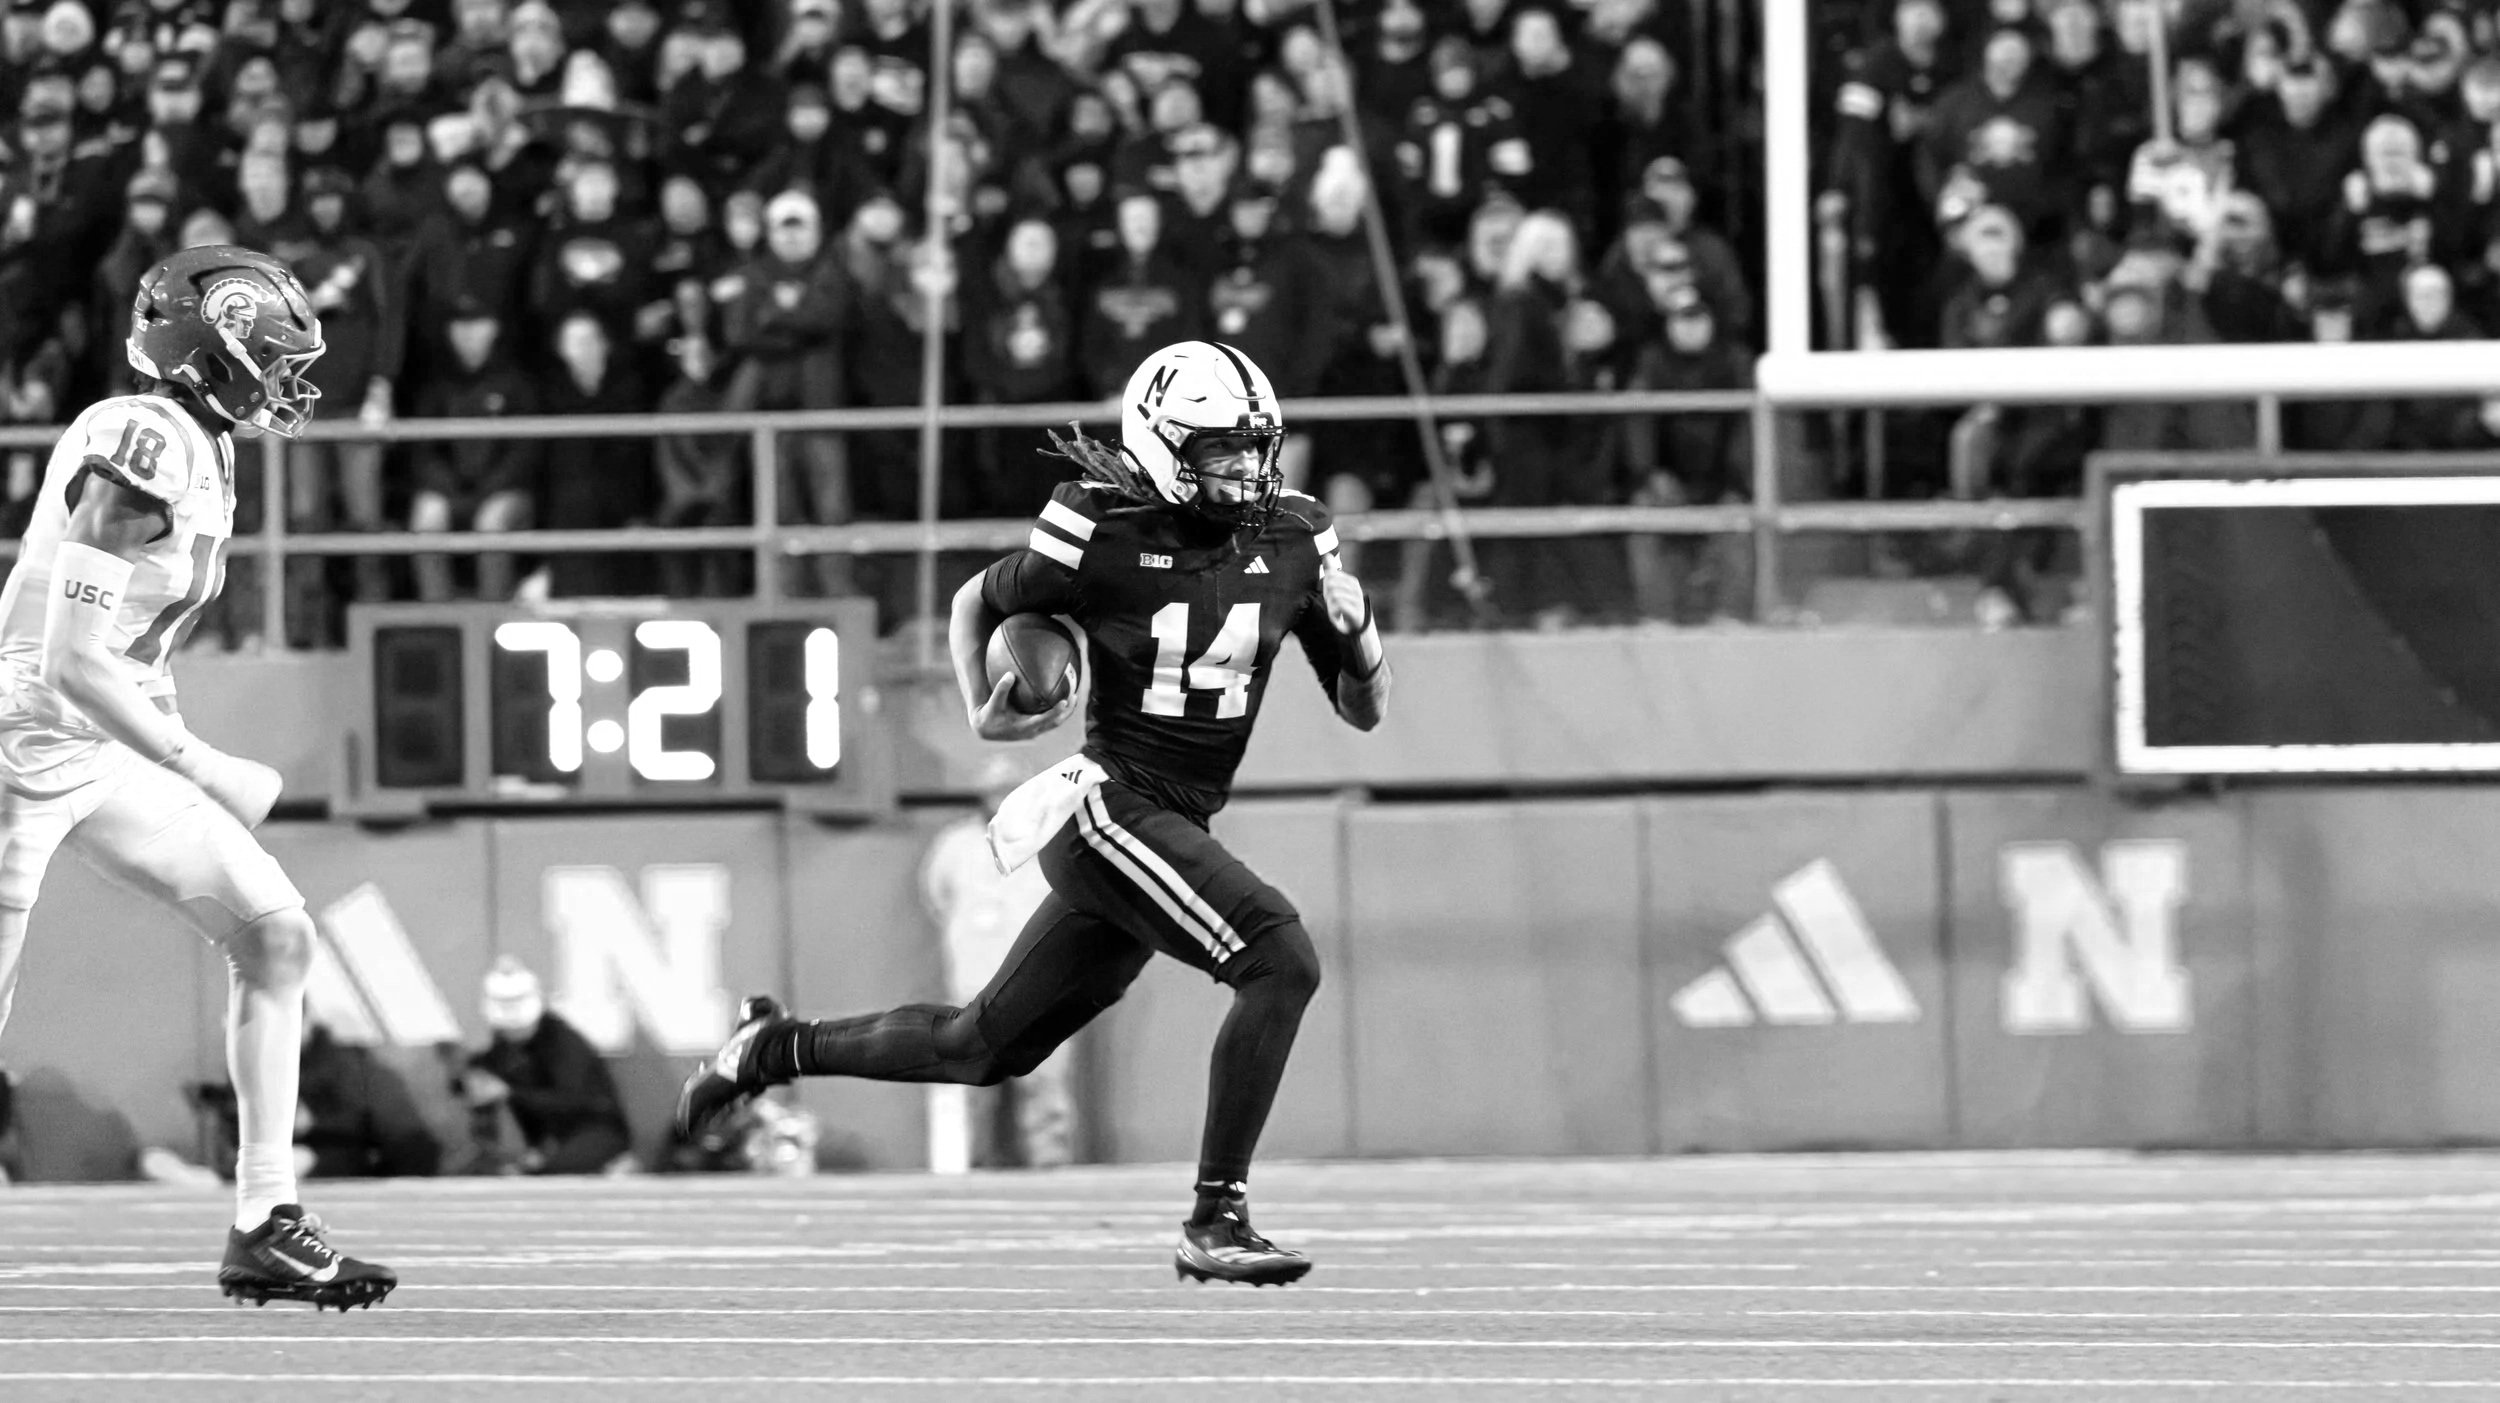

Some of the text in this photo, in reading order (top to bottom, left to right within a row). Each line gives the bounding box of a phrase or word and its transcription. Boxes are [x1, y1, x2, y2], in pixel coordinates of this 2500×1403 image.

[1144, 365, 1178, 408] N
[110, 418, 167, 481] 18
[65, 580, 114, 610] USC
[124, 533, 225, 667] 1
[495, 620, 840, 780] 7:21
[1141, 602, 1261, 719] 14
[542, 863, 732, 1057] N
[2000, 838, 2194, 1036] N
